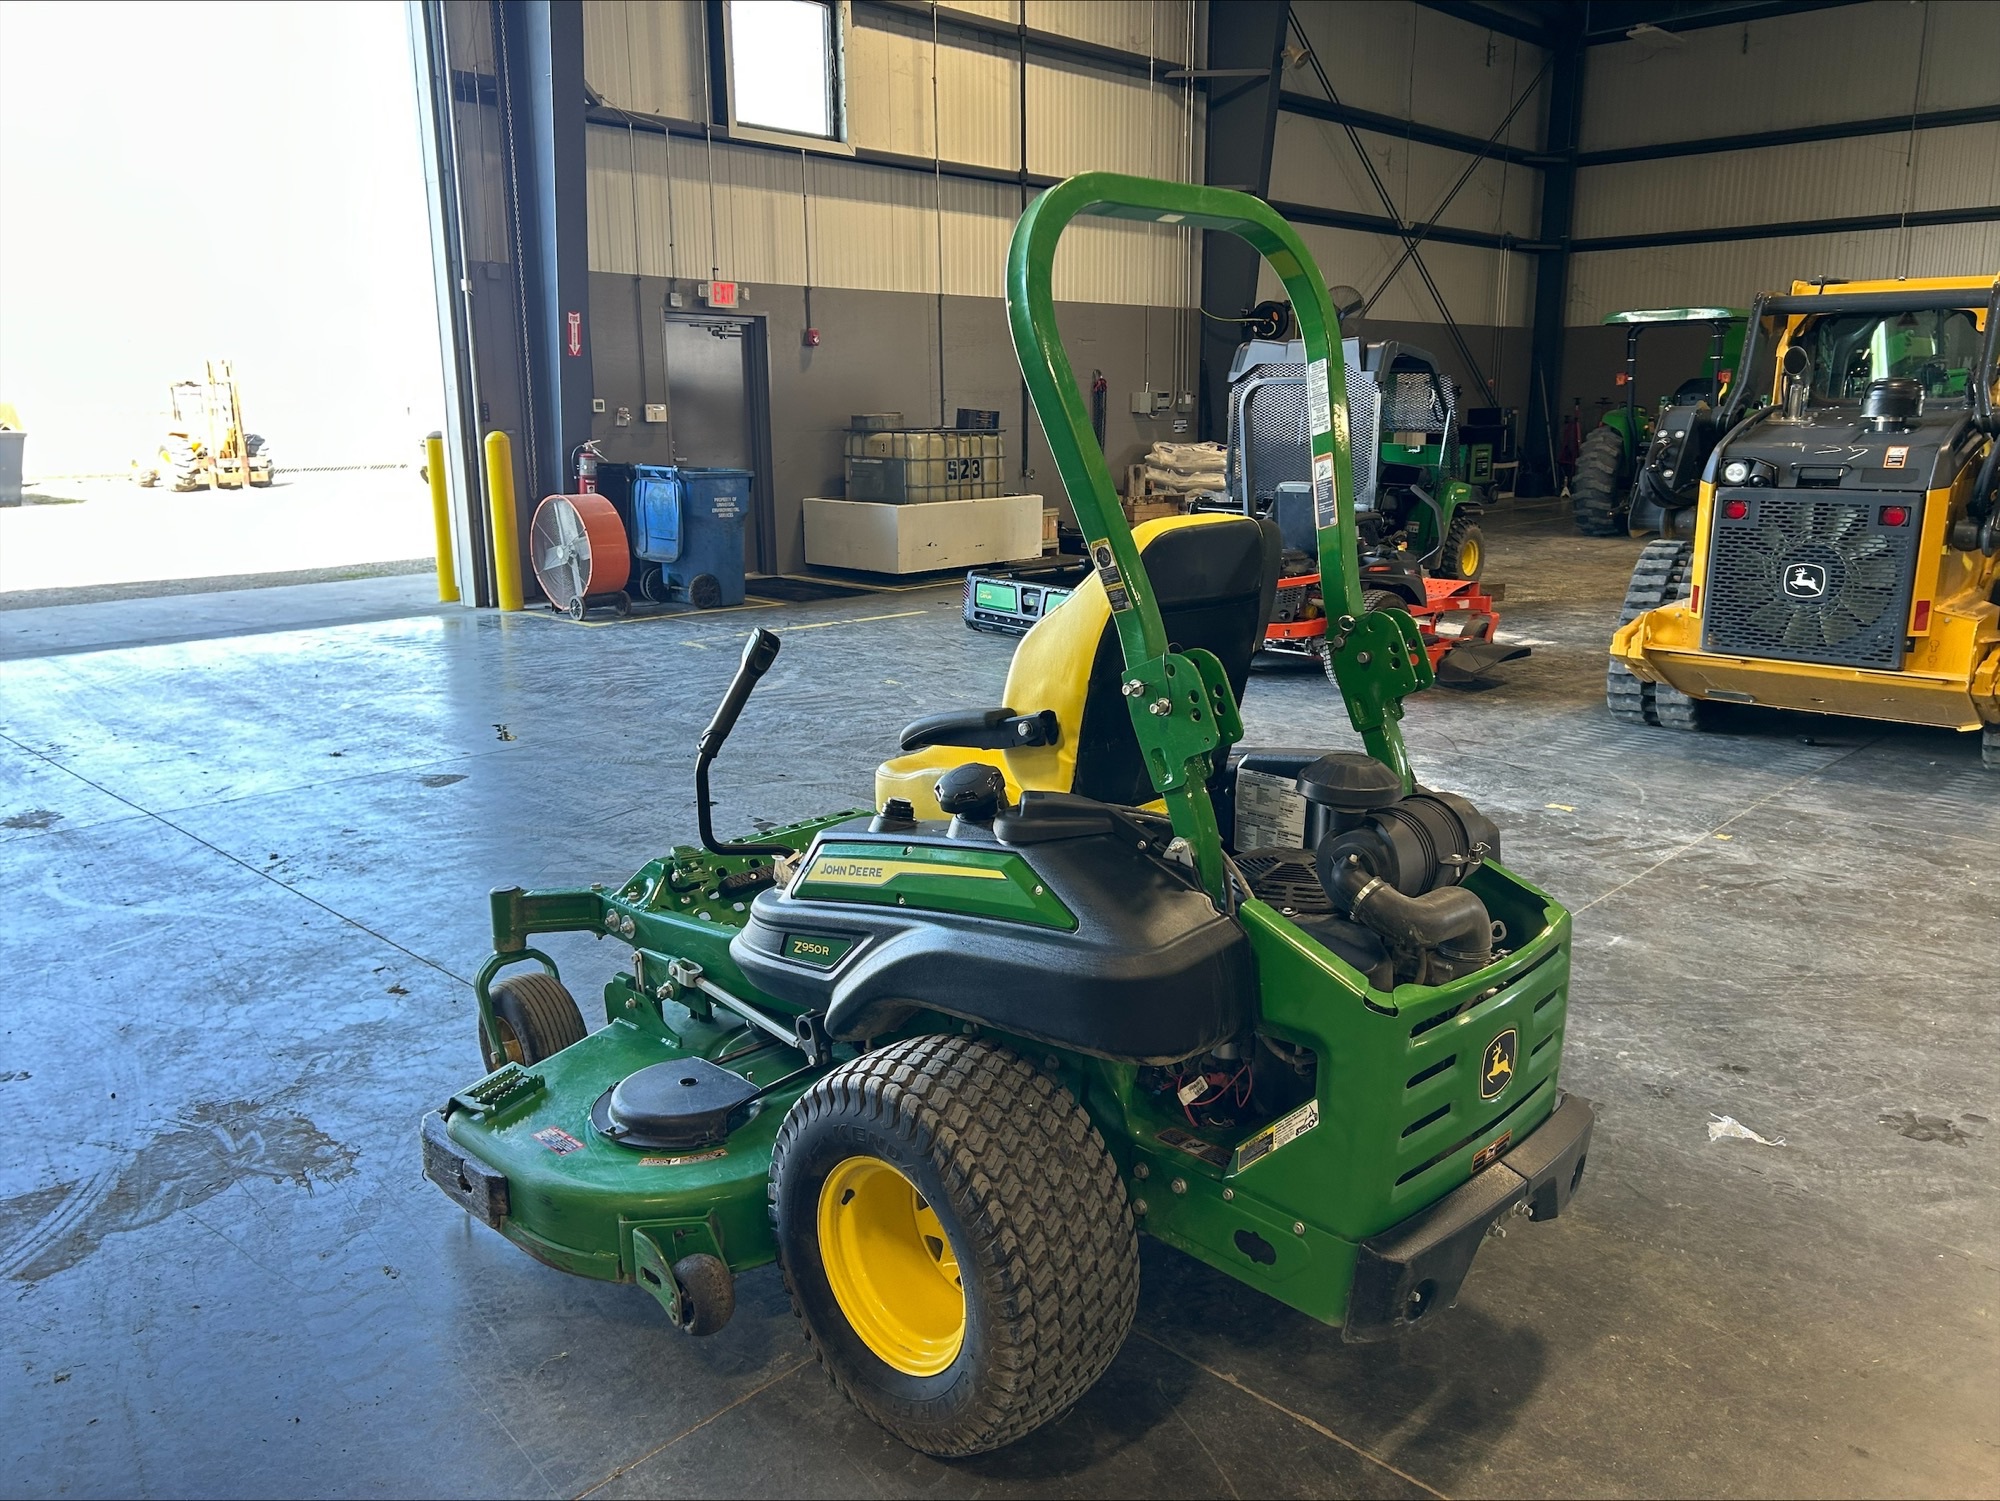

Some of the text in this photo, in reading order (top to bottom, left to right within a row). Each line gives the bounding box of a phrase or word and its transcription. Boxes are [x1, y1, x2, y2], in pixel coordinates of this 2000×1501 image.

[713, 282, 735, 304] EXIT
[820, 863, 883, 878] JOHN DEERE
[793, 941, 830, 956] Z950R
[832, 1123, 923, 1190] KENDA
